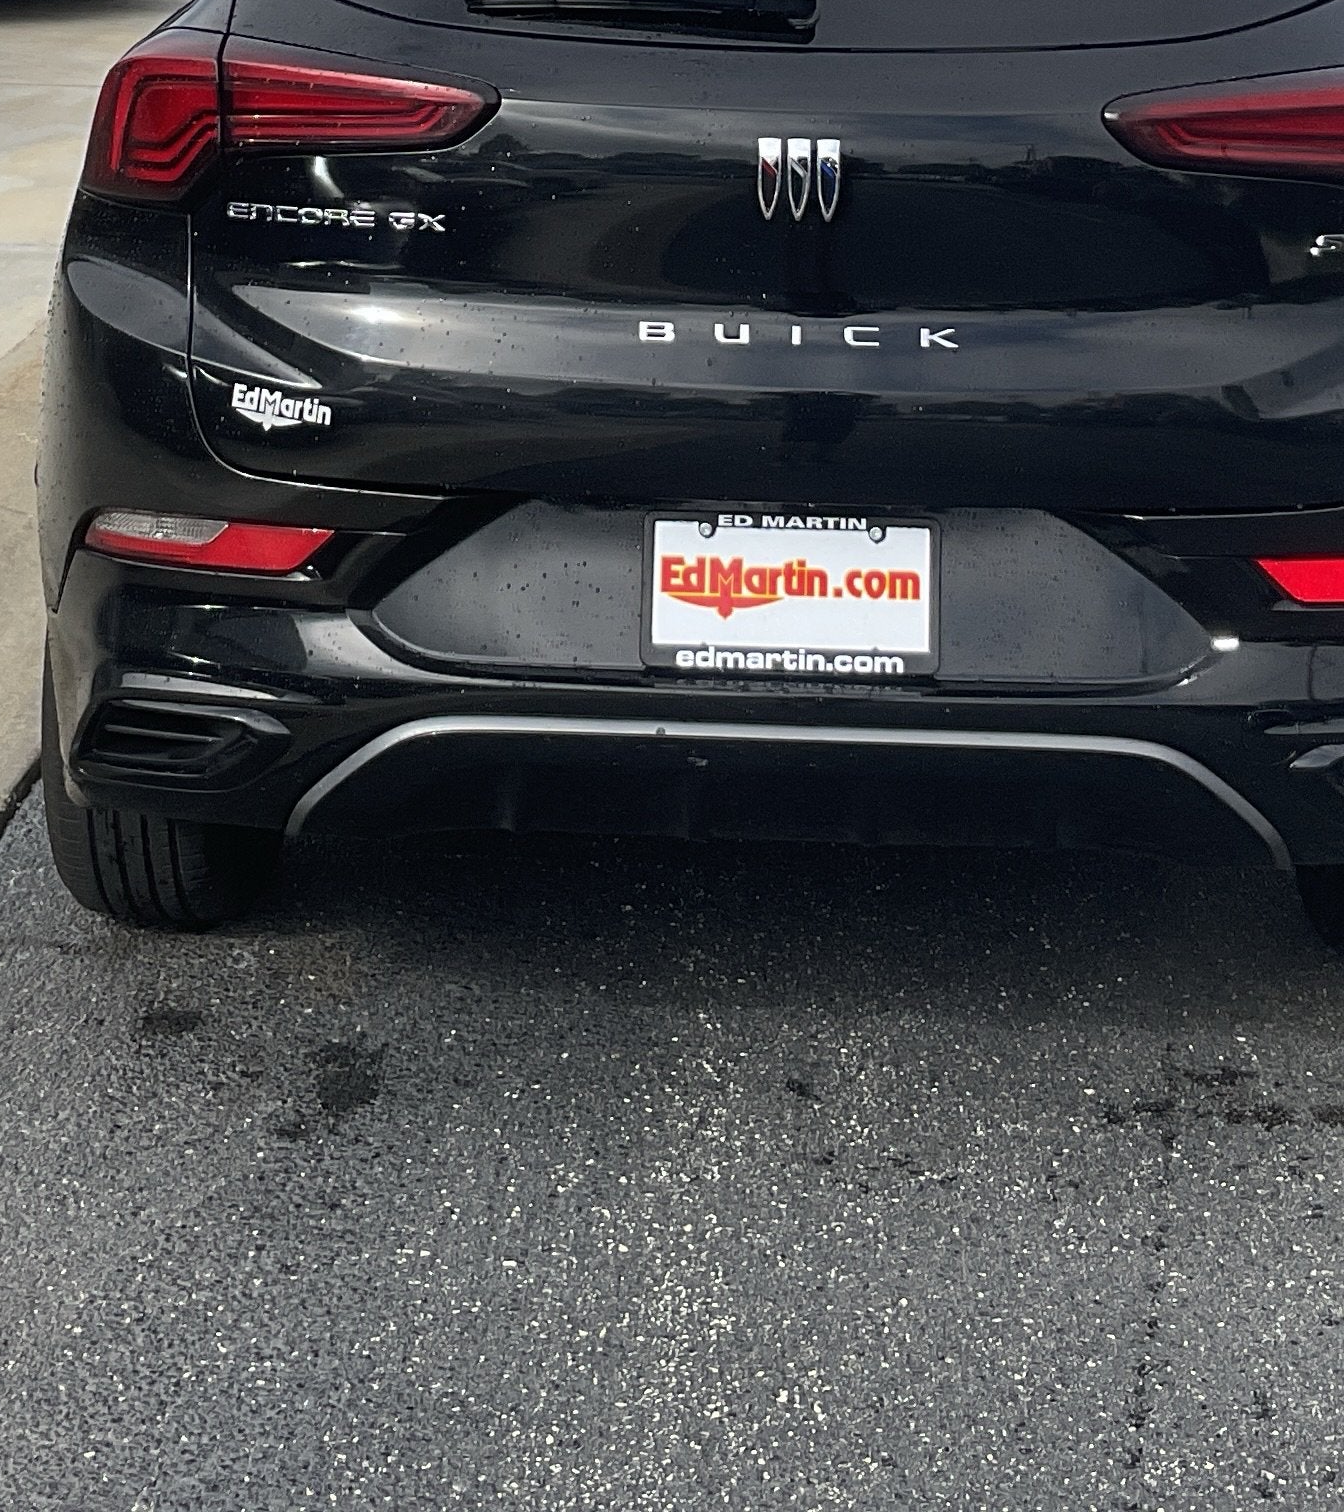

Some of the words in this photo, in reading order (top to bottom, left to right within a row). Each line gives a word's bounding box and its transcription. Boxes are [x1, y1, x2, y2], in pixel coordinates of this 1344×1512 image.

[226, 201, 376, 228] ENCORE
[388, 211, 447, 232] GX
[638, 320, 960, 349] BUICK
[231, 382, 332, 427] EdMartin
[718, 513, 753, 528] ED
[761, 515, 867, 531] MARTIN
[675, 645, 904, 674] edmartin.com
